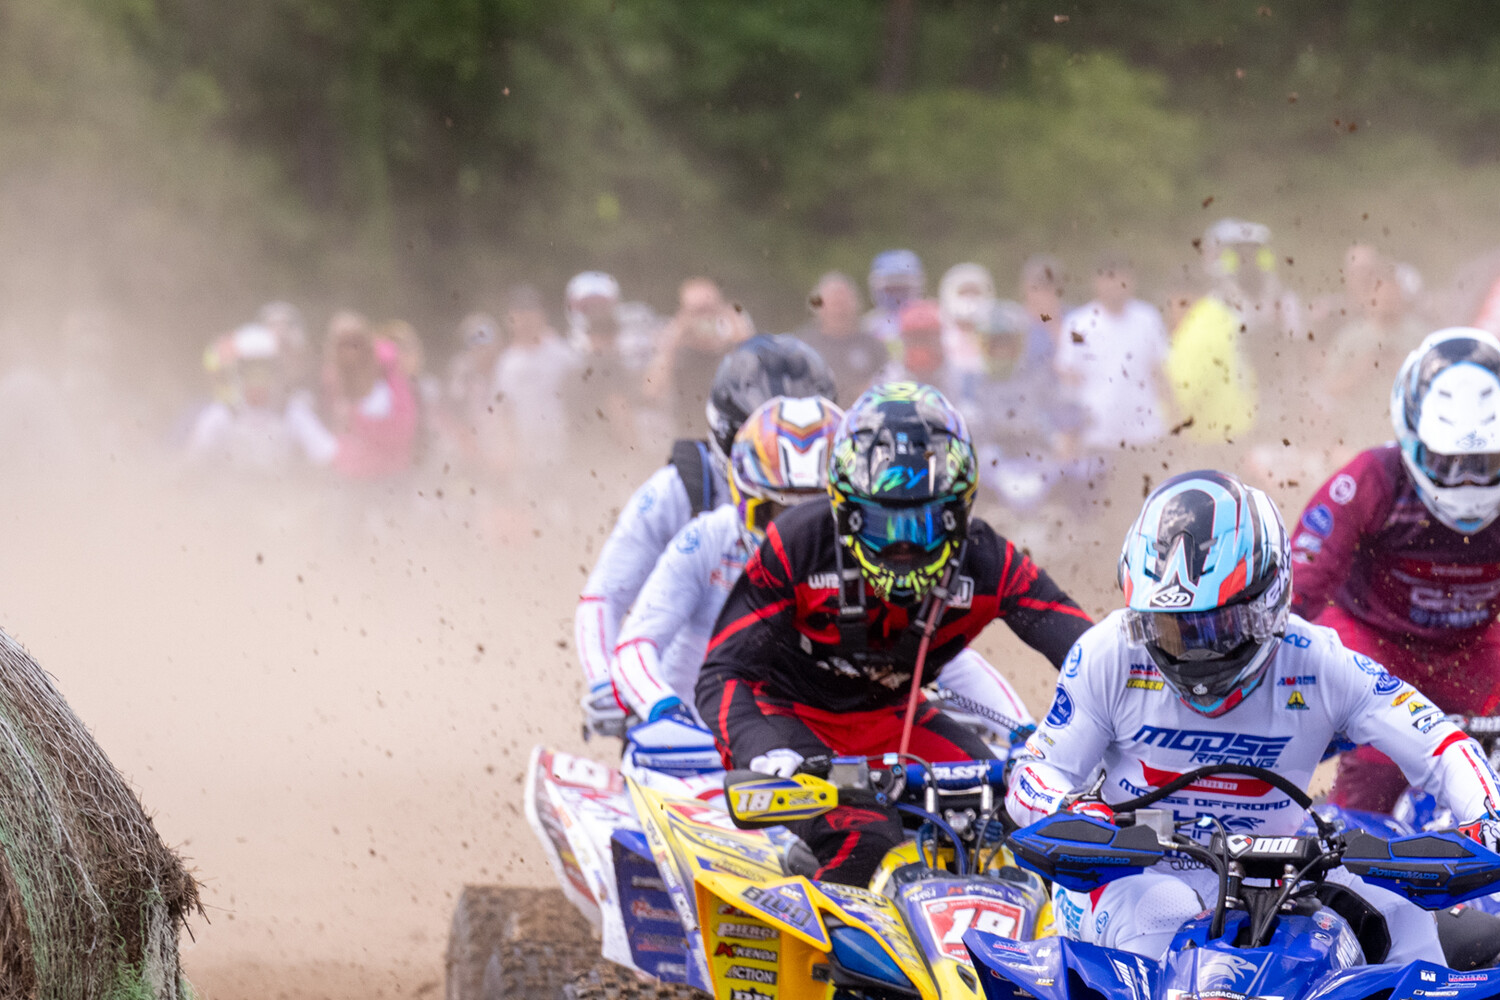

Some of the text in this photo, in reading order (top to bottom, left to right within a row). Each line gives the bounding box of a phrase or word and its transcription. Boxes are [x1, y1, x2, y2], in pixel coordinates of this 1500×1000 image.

[1131, 724, 1294, 758] MOOSE
[1188, 752, 1276, 768] RACING
[736, 791, 775, 813] 18
[1119, 777, 1190, 805] MOSE
[1193, 798, 1292, 811] OFFROAD
